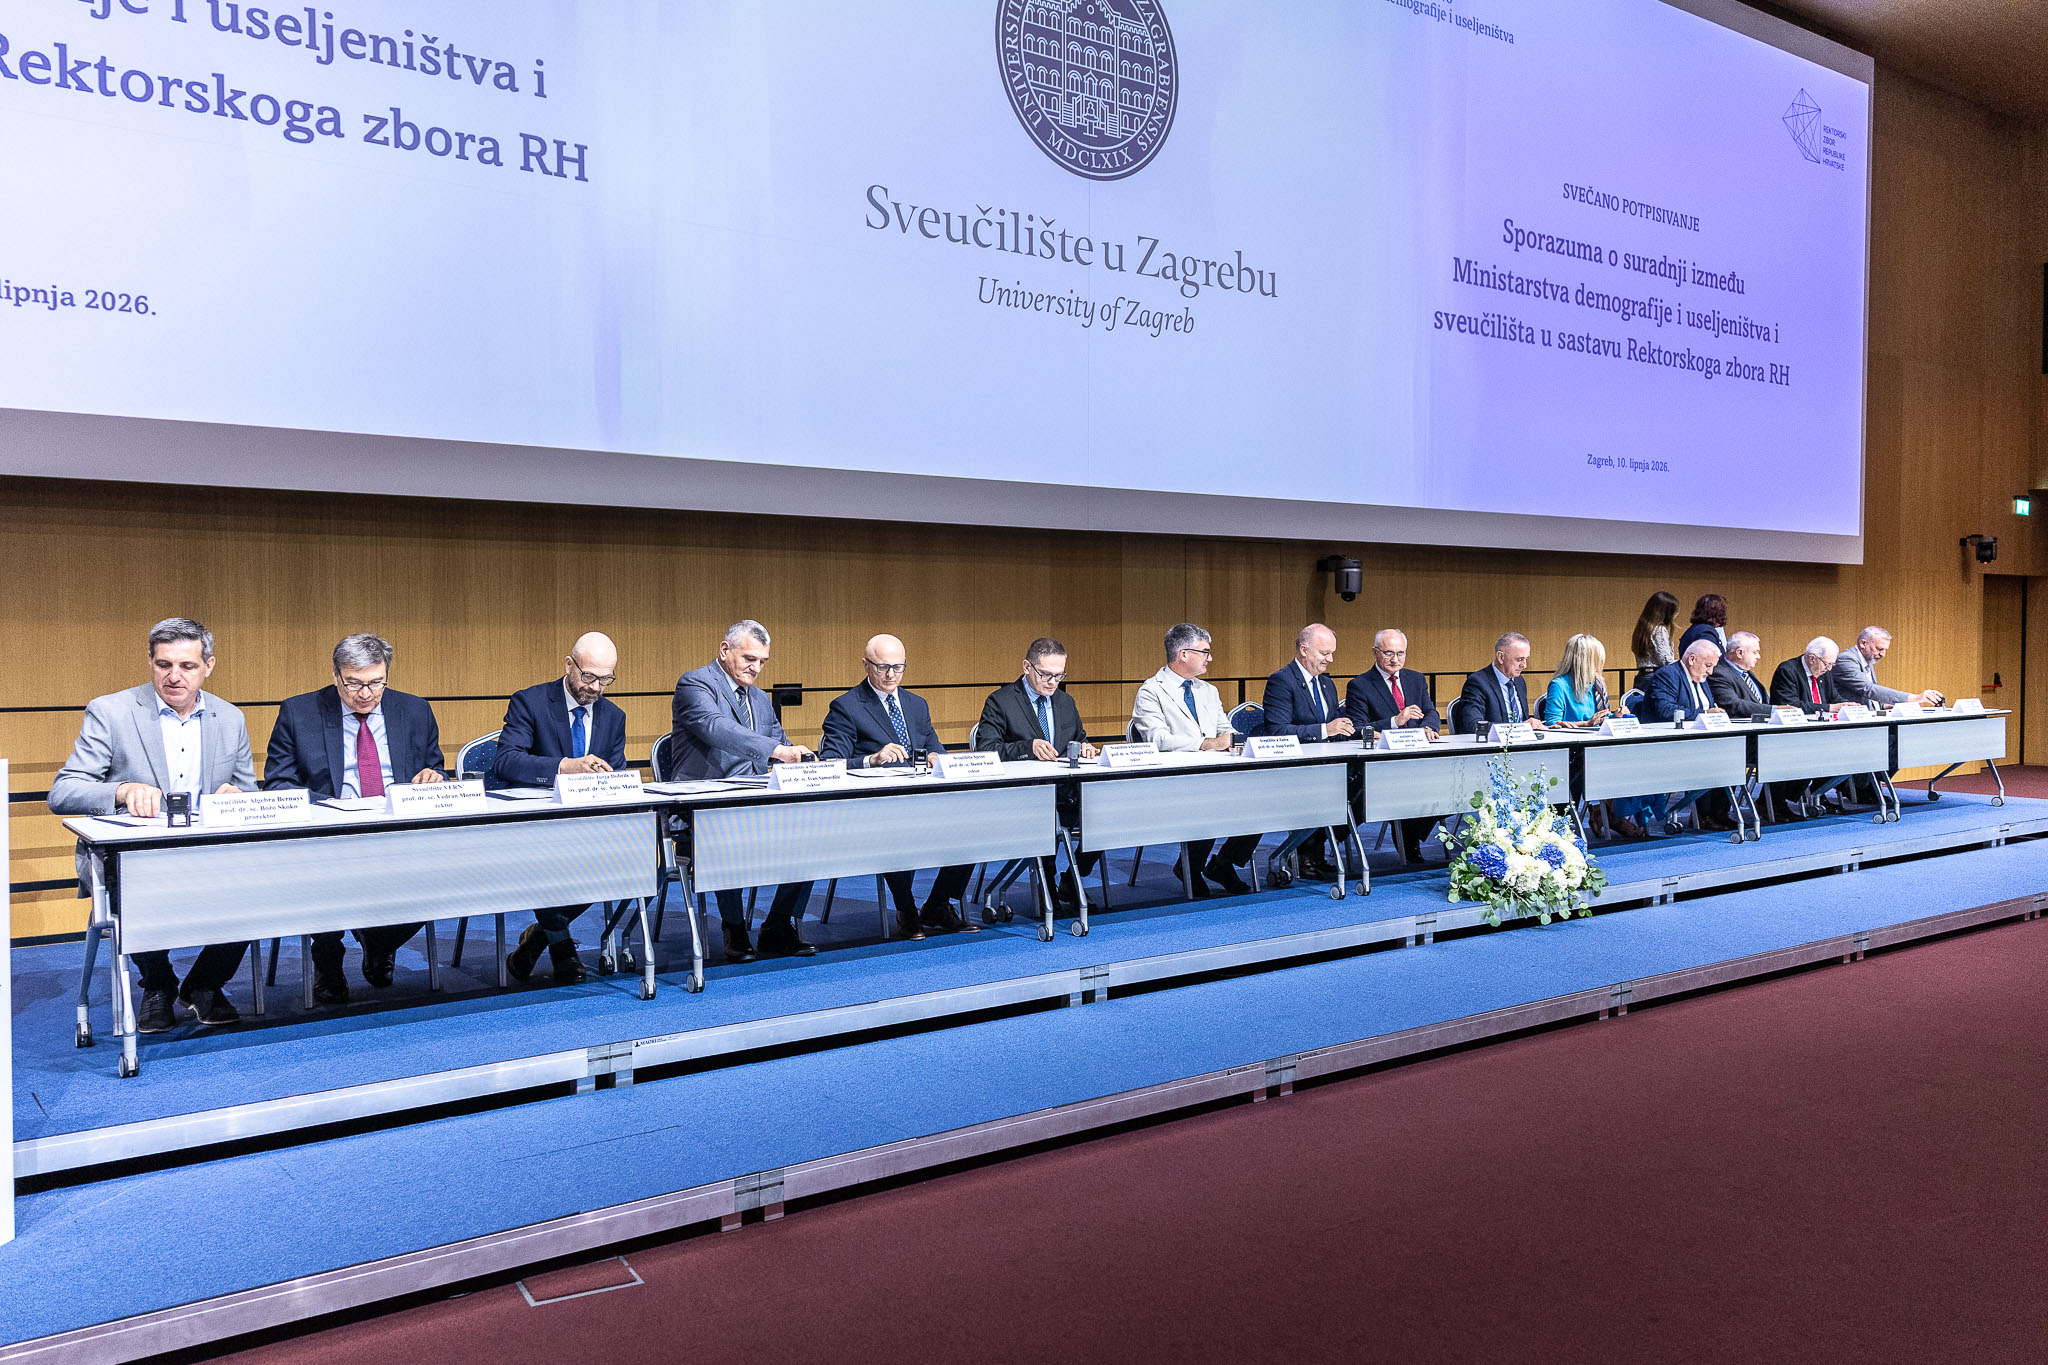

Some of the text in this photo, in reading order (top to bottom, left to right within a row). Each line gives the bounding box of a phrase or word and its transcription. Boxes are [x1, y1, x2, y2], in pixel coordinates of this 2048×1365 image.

[1385, 0, 1514, 44] mografije i useljeništva
[206, 0, 519, 92] useljeništva
[534, 59, 547, 98] i
[1005, 0, 1042, 128] UNIVERSIT
[363, 107, 503, 167] zbora
[519, 133, 588, 182] RH
[1046, 128, 1134, 169] MDCLXIX
[1823, 125, 1848, 139] REKTORSKI
[1823, 135, 1836, 146] ZBOR
[1823, 147, 1846, 161] REPUBLIKE
[1823, 158, 1845, 171] HRVATSKE
[1563, 183, 1699, 232] SVEČANO POTPISIVANJE
[866, 185, 1278, 298] Sveučilište u Zagrebu
[1503, 218, 1745, 294] Sporazuma o suradnji između
[0, 279, 156, 315] ipnja 2026.
[979, 276, 1195, 338] University of Zagreb
[1453, 257, 1779, 343] Ministarstva demografije i useljeništva i
[1434, 311, 1790, 386] sveučilišta u sastavu Rektorskoga zbora RH
[1587, 454, 1669, 472] Zagreb, 10. lipnja 2026.
[220, 807, 236, 815] prof.
[244, 813, 277, 821] prorektor
